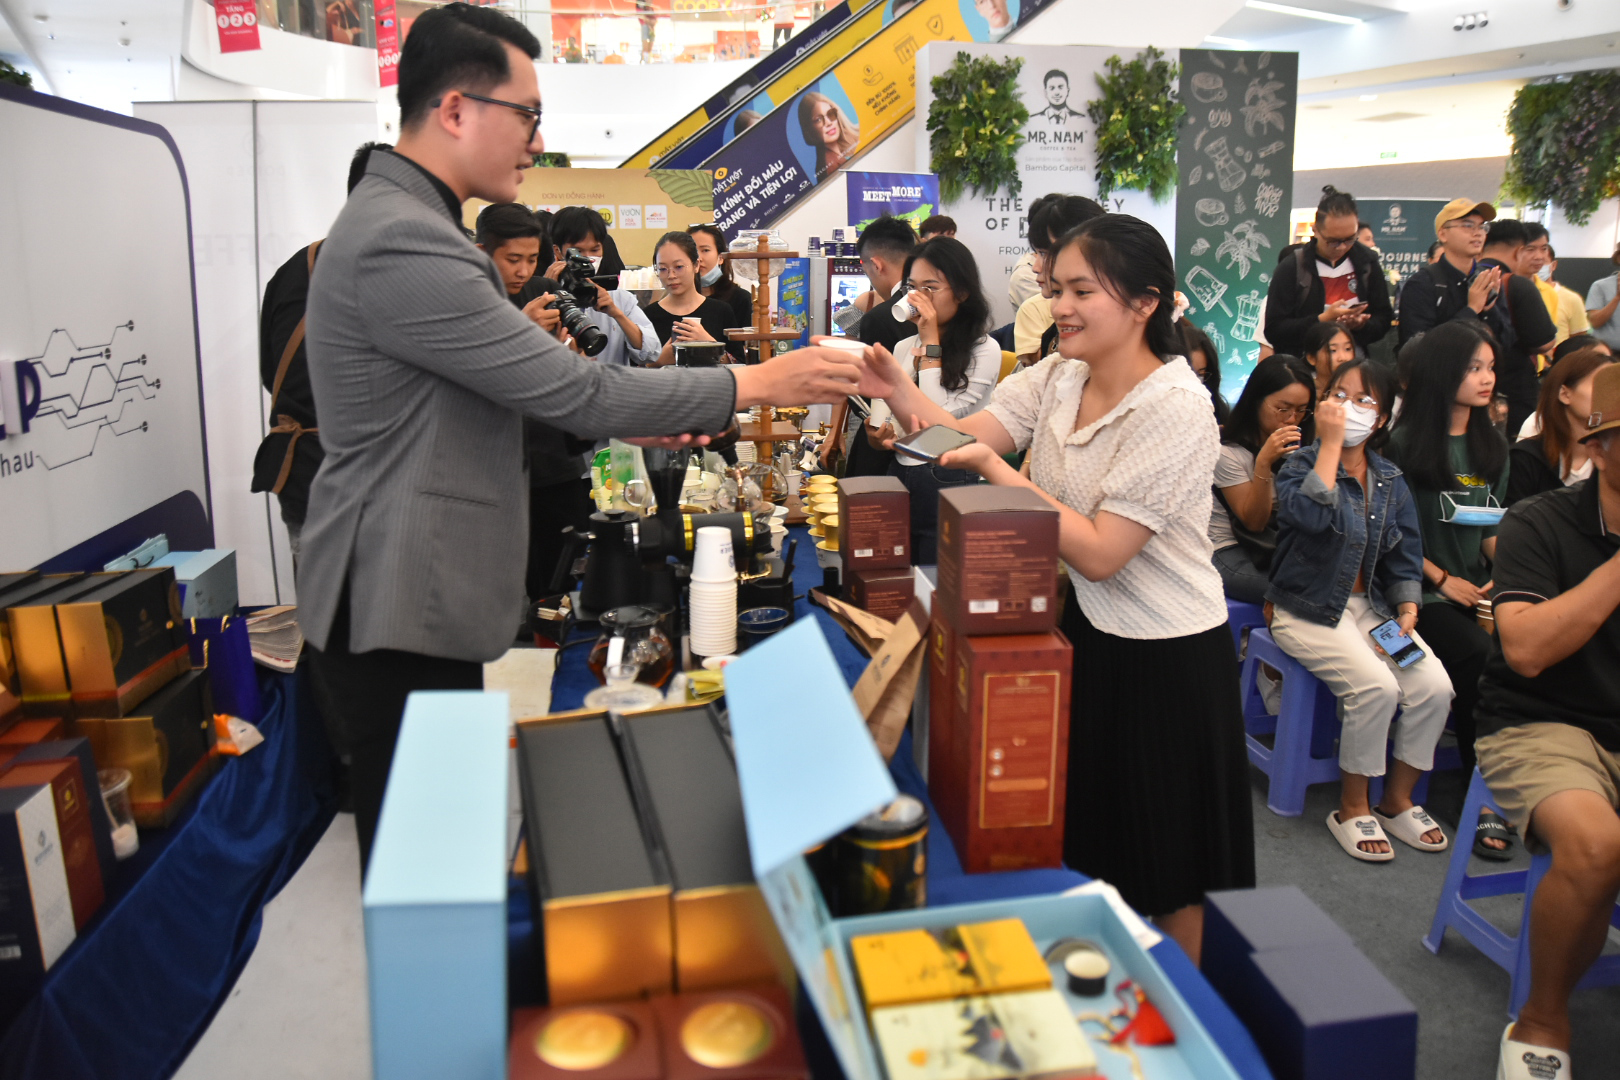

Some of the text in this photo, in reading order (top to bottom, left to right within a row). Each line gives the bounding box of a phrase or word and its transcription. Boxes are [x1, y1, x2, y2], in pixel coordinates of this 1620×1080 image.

[1060, 164, 1086, 172] Capital
[721, 190, 745, 214] KÍNH
[744, 174, 763, 194] ĐỔI
[762, 160, 784, 183] MÀU
[892, 186, 922, 198] MORE
[587, 192, 604, 200] HÀNH
[717, 208, 746, 232] RANG
[744, 195, 761, 210] VÀ
[760, 180, 782, 199] TIỆN
[780, 166, 798, 184] LỢI
[863, 191, 892, 202] MEET
[986, 198, 1023, 212] THE
[986, 218, 1010, 230] OF
[999, 246, 1030, 254] FROM
[1378, 252, 1428, 262] JOURNE
